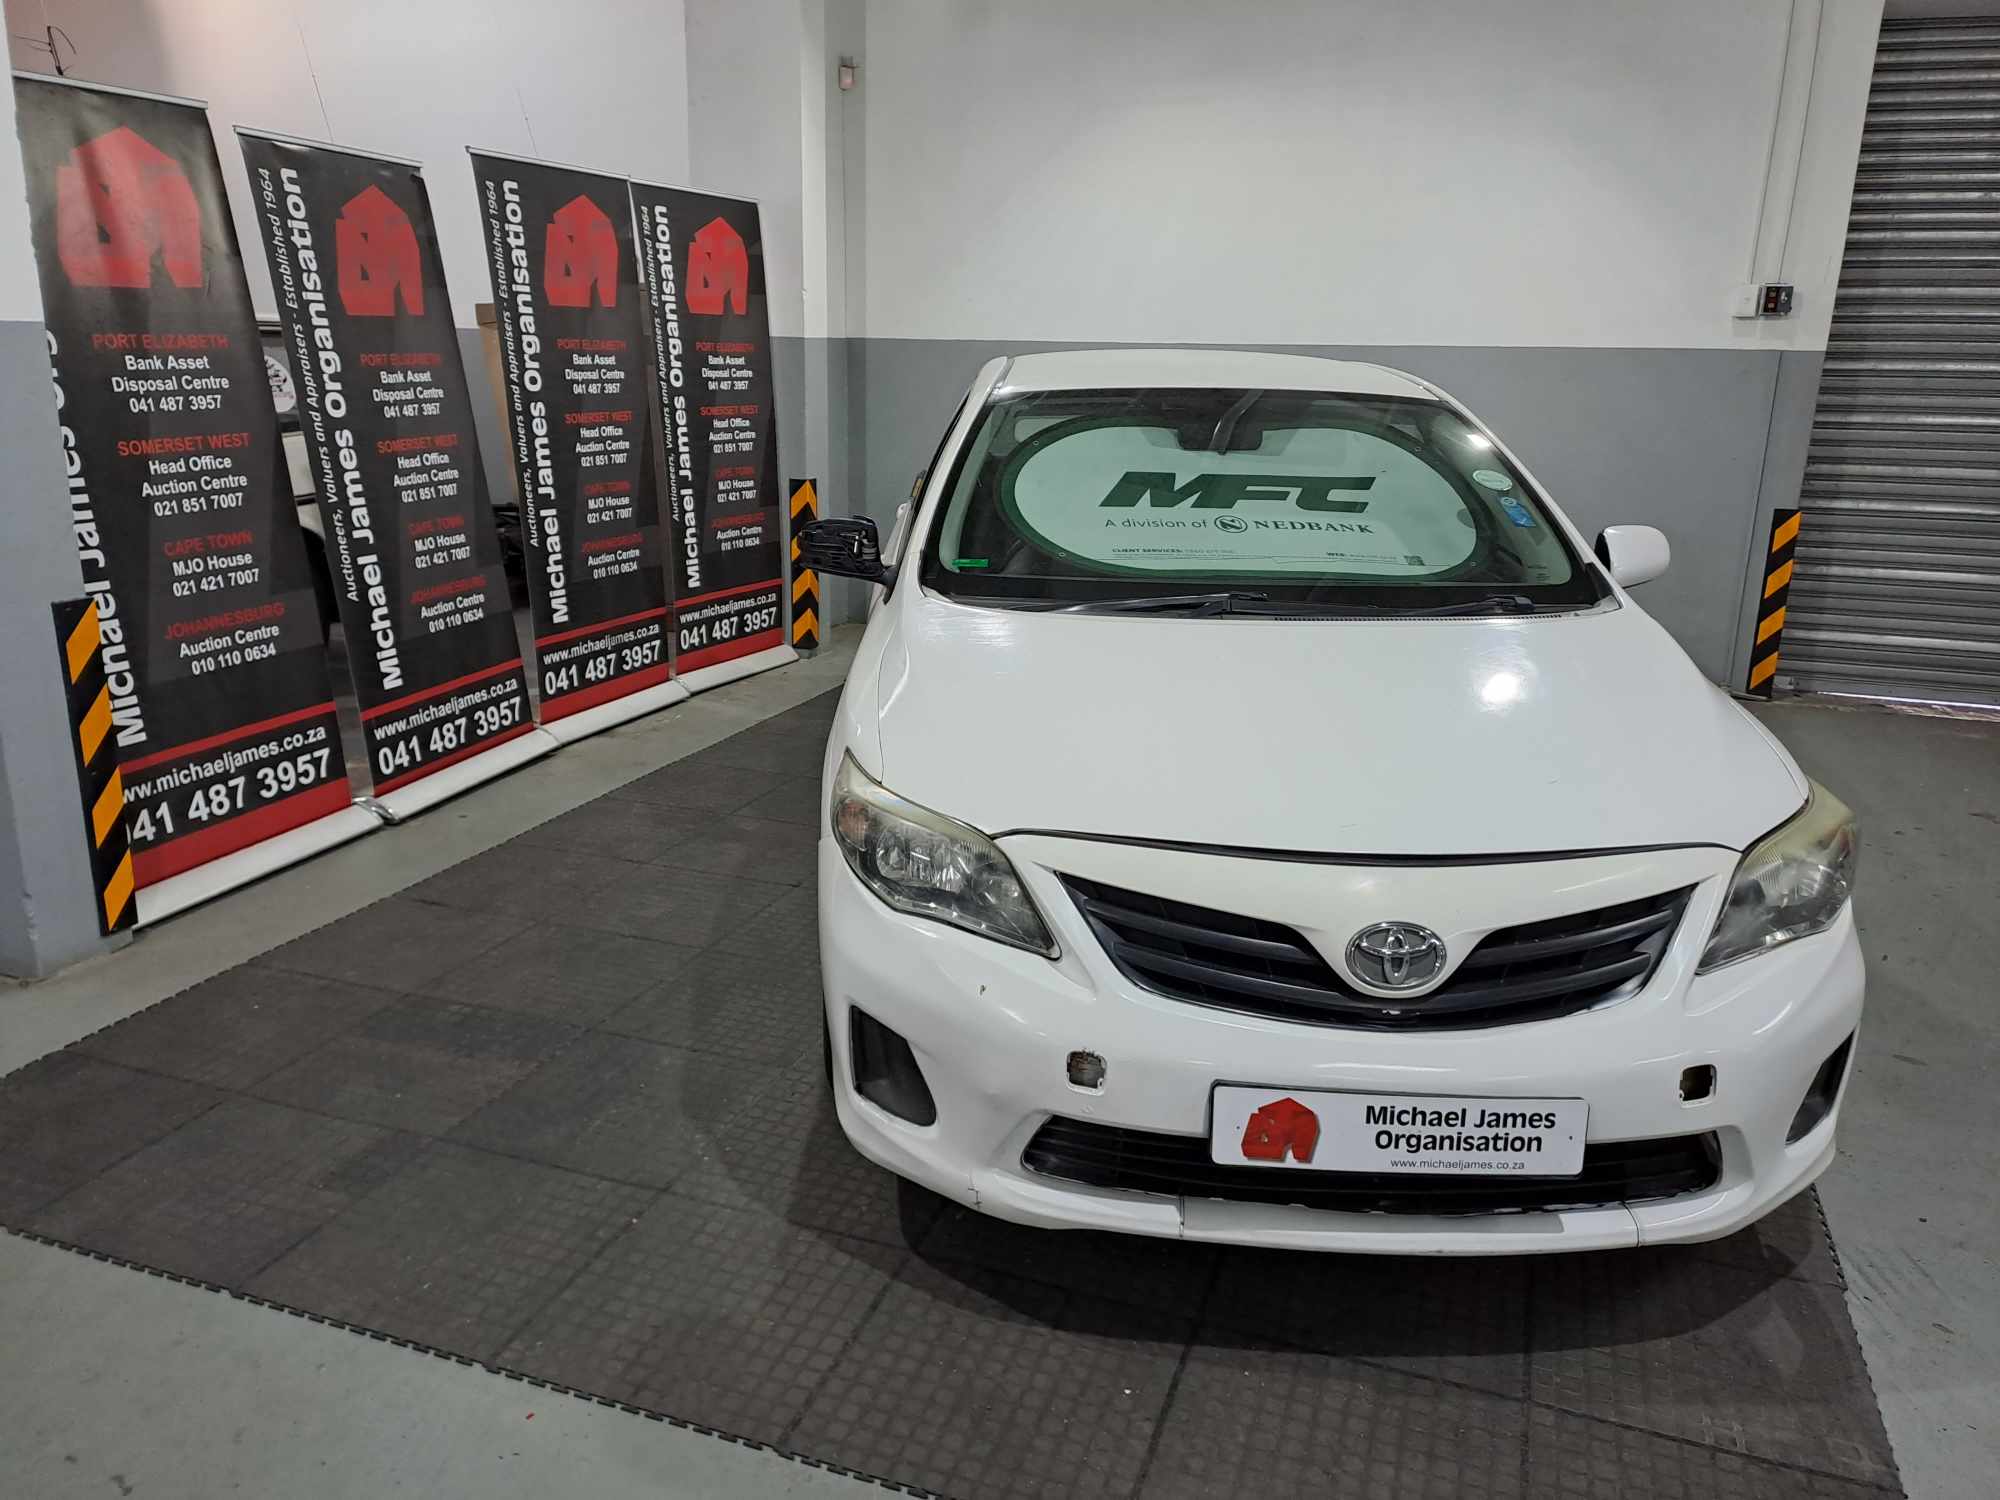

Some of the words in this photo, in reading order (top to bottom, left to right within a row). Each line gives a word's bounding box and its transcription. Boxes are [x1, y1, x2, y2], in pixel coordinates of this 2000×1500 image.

[257, 167, 277, 211] 1964
[485, 180, 498, 215] 1964
[267, 213, 299, 309] Established
[489, 218, 508, 299] Established
[280, 168, 347, 418] Organisation
[502, 180, 542, 392] Organisation
[654, 205, 684, 388] Organisation
[92, 334, 137, 347] PORT
[143, 334, 229, 347] ELIZABETH
[502, 311, 521, 383] Appraisers
[125, 355, 164, 370] Bank
[168, 355, 209, 369] Asset
[293, 322, 317, 408] Appraisers
[572, 354, 592, 365] Bank
[594, 354, 616, 365] Asset
[112, 376, 177, 395] Disposal
[181, 376, 229, 391] Centre
[380, 370, 405, 383] Bank
[407, 370, 432, 382] Asset
[564, 368, 599, 381] Disposal
[373, 388, 415, 404] Disposal
[416, 387, 444, 400] Centre
[511, 385, 522, 412] and
[587, 383, 601, 394] 487
[129, 398, 155, 413] 041
[159, 397, 183, 412] 487
[190, 395, 222, 410] 3957
[384, 405, 400, 417] 041
[403, 404, 419, 416] 487
[309, 410, 325, 443] and
[516, 415, 529, 463] Valuers
[580, 426, 599, 439] Head
[674, 395, 692, 481] James
[118, 436, 202, 456] SOMERSET
[208, 433, 249, 448] WEST
[530, 401, 555, 500] James
[576, 442, 604, 453] Auction
[605, 440, 629, 450] Centre
[149, 458, 185, 475] Head
[189, 456, 232, 471] Office
[397, 455, 421, 469] Head
[423, 453, 449, 466] Office
[581, 456, 593, 466] 021
[595, 454, 608, 465] 851
[142, 478, 197, 497] Auction
[201, 473, 248, 491] Centre
[317, 446, 338, 503] Valuers
[335, 429, 374, 544] James
[394, 471, 429, 487] Auction
[431, 468, 459, 482] Centre
[154, 501, 178, 517] 021
[183, 498, 207, 512] 851
[210, 493, 243, 508] 7007
[401, 490, 417, 503] 021
[420, 487, 436, 499] 851
[588, 497, 604, 509] MJO
[605, 496, 630, 506] House
[1098, 471, 1377, 514] MFC
[523, 468, 540, 547] Auctioneers,
[601, 510, 613, 521] 421
[680, 489, 701, 588] Michael
[1105, 518, 1117, 528] A
[1121, 517, 1187, 529] division
[1191, 518, 1209, 529] of
[1253, 519, 1375, 535] NEDBANK
[164, 538, 202, 556] CAPE
[208, 531, 252, 547] TOWN
[332, 509, 360, 602] Auctioneers,
[414, 537, 435, 552] MJO
[436, 533, 466, 548] House
[172, 558, 204, 576] MJO
[207, 552, 253, 570] House
[415, 555, 431, 569] 021
[433, 551, 449, 564] 421
[540, 508, 569, 624] Michael
[587, 553, 615, 567] Auction
[172, 580, 196, 597] 021
[200, 575, 224, 591] 421
[228, 568, 259, 586] 7007
[421, 601, 455, 619] Auction
[456, 592, 485, 609] Centre
[680, 592, 776, 624] www.michaeljames.co.za
[357, 554, 404, 691] Michael
[429, 619, 444, 633] 010
[447, 614, 461, 628] 110
[680, 624, 707, 650] 041
[712, 616, 738, 641] 487
[743, 606, 777, 633] 3957
[179, 635, 231, 658] Auction
[235, 624, 280, 645] Centre
[543, 623, 659, 665] www.michaeljames.co.za
[85, 580, 147, 747] Michael
[191, 656, 215, 676] 010
[218, 650, 241, 669] 110
[244, 642, 276, 663] 0634
[544, 664, 578, 695] 041
[585, 652, 617, 683] 487
[622, 639, 661, 671] 3957
[374, 676, 518, 741] www.michaeljames.co.za
[378, 736, 422, 776] 041
[430, 717, 467, 753] 487
[474, 696, 521, 736] 3957
[124, 725, 326, 804] ww.michaeljames.co.za
[126, 801, 175, 844] 41
[188, 777, 246, 822] 487
[257, 748, 330, 798] 3957
[1365, 1105, 1467, 1128] Michael
[1474, 1108, 1557, 1130] James
[1375, 1129, 1543, 1154] Organisation
[1390, 1158, 1525, 1172] www.michaeljames.co.za
